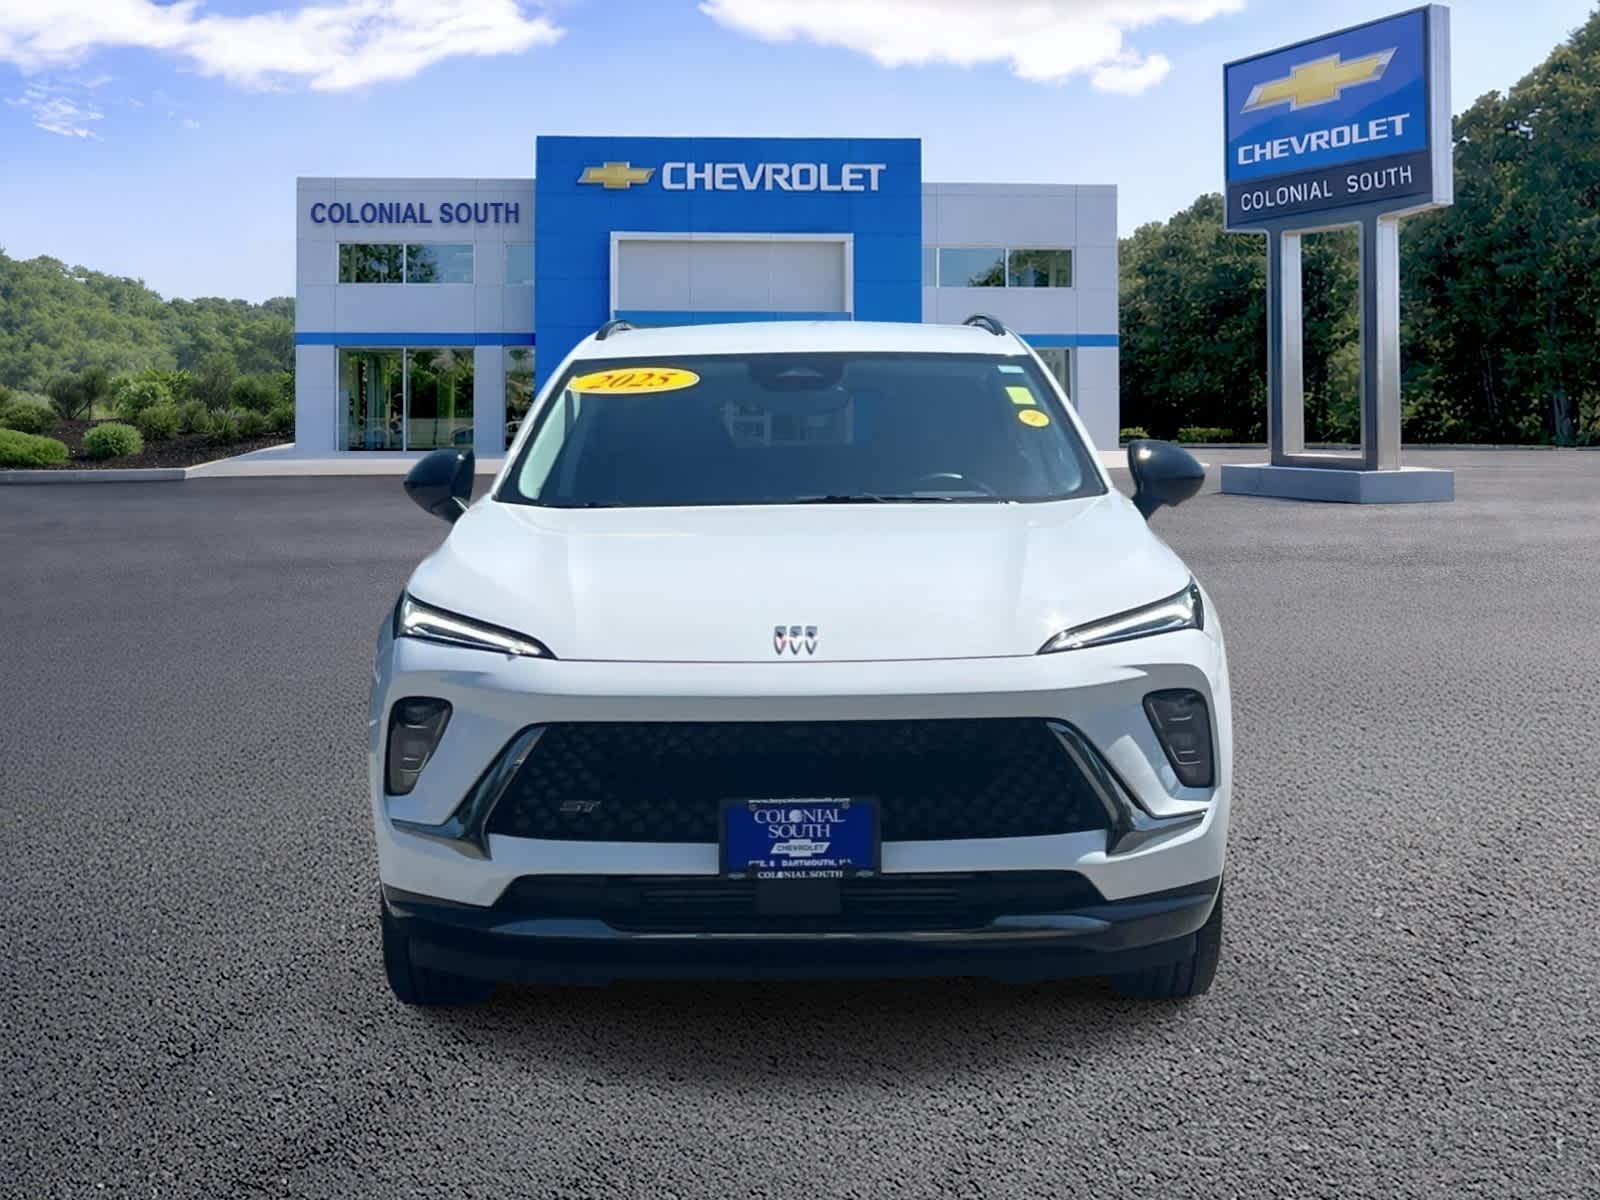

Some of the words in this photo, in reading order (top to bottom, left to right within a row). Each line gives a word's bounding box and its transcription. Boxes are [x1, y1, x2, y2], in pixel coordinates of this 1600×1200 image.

[1237, 112, 1410, 165] CHEVROLET
[662, 162, 887, 192] CHEVROLET
[1240, 179, 1333, 212] COLONIAL
[1346, 164, 1413, 194] SOUTH
[310, 202, 433, 224] COLONIAL
[439, 202, 520, 224] SOUTH
[585, 371, 678, 390] 2025
[754, 808, 846, 824] COLONIAL
[768, 823, 830, 838] SOUTH
[776, 844, 824, 852] CHEVROLET
[757, 870, 808, 879] COLONIAL
[809, 870, 844, 879] SOUTH
